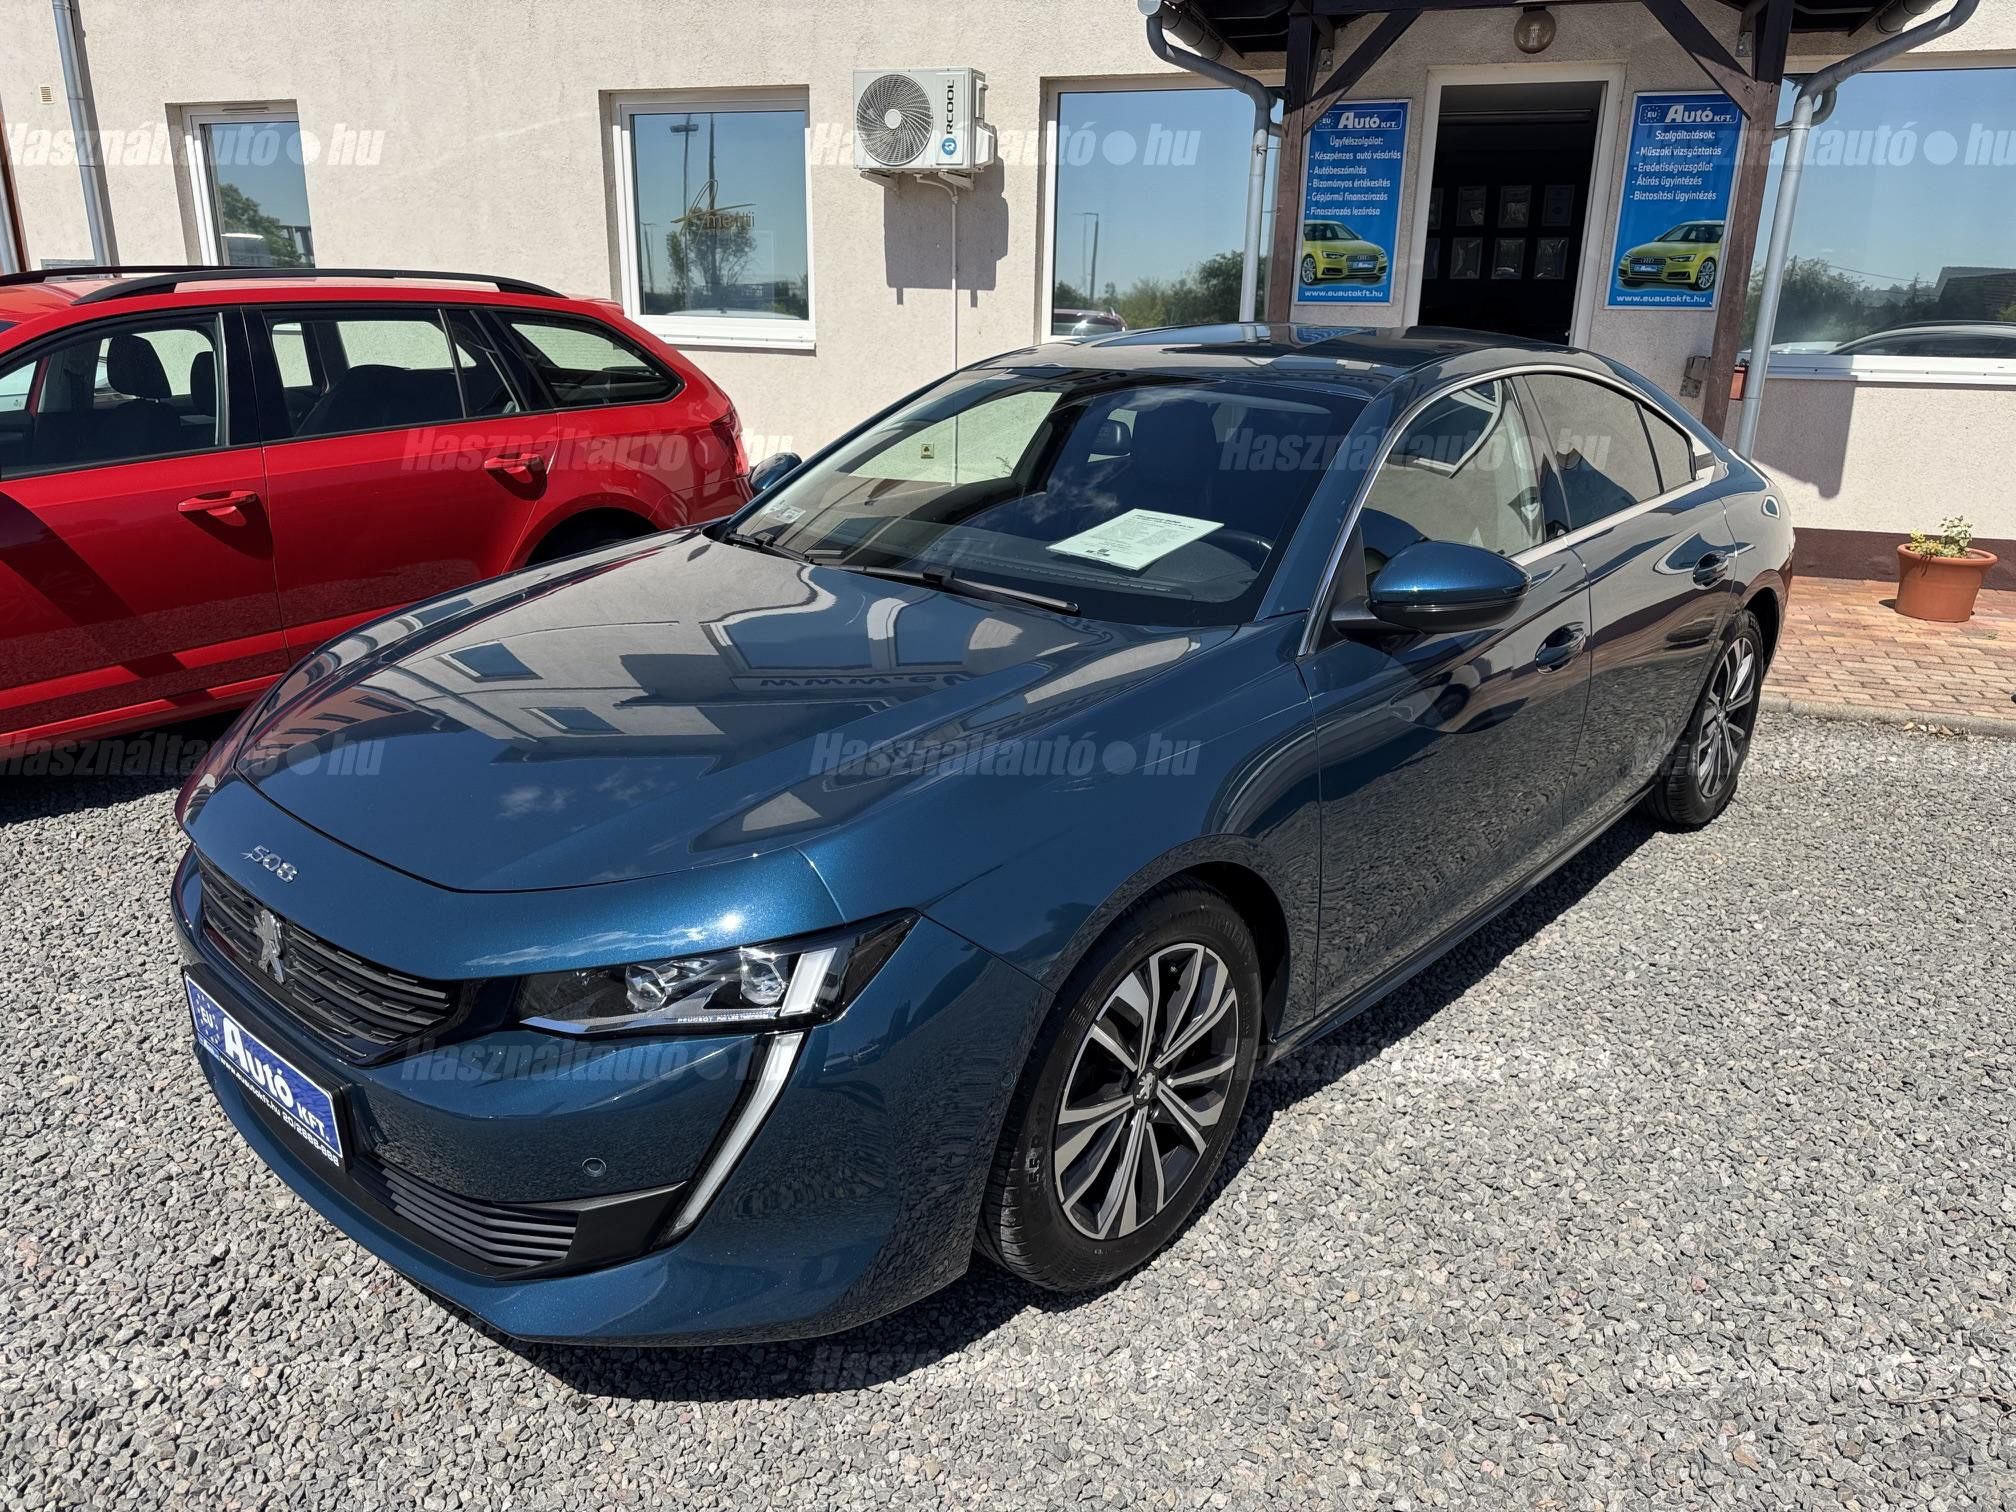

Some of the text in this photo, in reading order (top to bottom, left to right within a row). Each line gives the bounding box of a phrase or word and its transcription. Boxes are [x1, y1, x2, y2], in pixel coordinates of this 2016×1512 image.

[946, 79, 955, 135] RCOOL
[1665, 105, 1713, 123] Autó
[1338, 112, 1380, 129] Autó
[1655, 130, 1716, 142] Szolgáltatások:
[1356, 150, 1372, 160] autó
[250, 845, 298, 883] 508
[223, 1017, 294, 1108] Autó
[296, 1104, 330, 1142] KFT.
